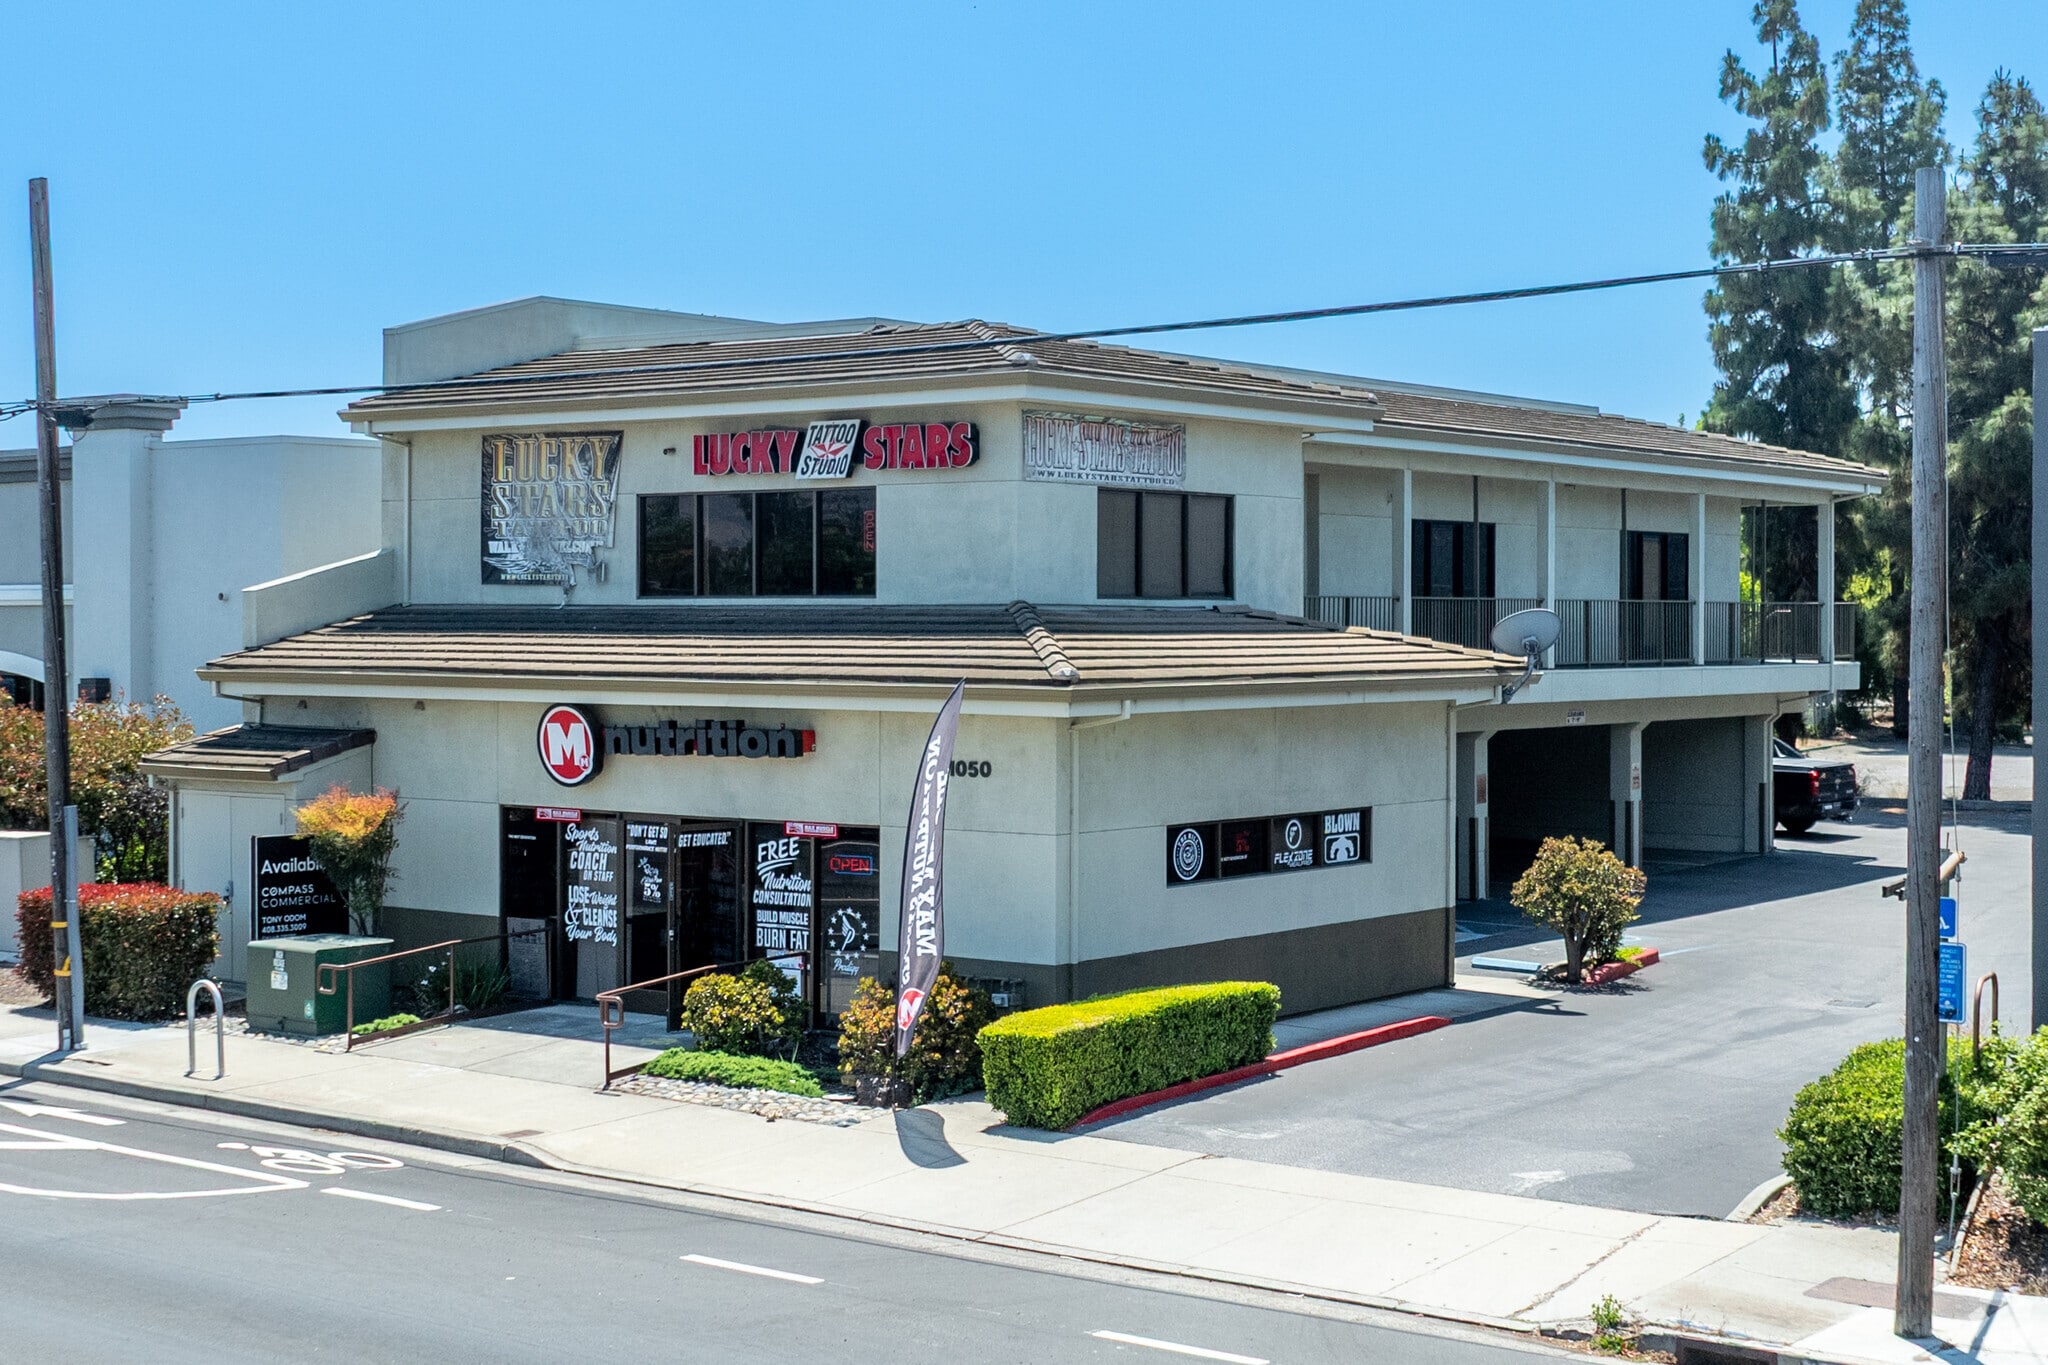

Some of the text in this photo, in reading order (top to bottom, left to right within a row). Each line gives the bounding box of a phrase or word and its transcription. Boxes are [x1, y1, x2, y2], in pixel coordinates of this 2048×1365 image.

[807, 422, 854, 446] TATTOO
[693, 421, 972, 475] LUCKY STARS
[1026, 415, 1183, 477] LUCKY STARS TATTOO
[491, 437, 613, 484] LUCKY
[800, 455, 848, 476] STUDIO
[491, 482, 609, 519] STARS
[604, 719, 802, 758] nutrition
[949, 759, 992, 778] 1050
[565, 822, 599, 842] Sports
[648, 825, 660, 838] GET
[660, 826, 668, 839] SO
[1324, 812, 1360, 834] BLOWN
[576, 840, 617, 854] Nutrition
[678, 833, 692, 847] GET
[758, 837, 800, 862] FREE
[570, 851, 608, 871] COACH
[830, 857, 870, 872] OPEN
[583, 870, 614, 882] ON STAFF
[761, 871, 812, 892] Nutrition
[261, 884, 315, 897] COMPASS
[568, 885, 617, 909] LOSE Weight
[643, 882, 661, 898] 5%
[753, 890, 812, 907] CONSULTATION
[261, 894, 337, 908] COMMERCIAL
[262, 913, 307, 924] TONY ODOM
[582, 908, 617, 928] CLEANSE
[756, 909, 809, 925] BUILD MUSCLE
[566, 924, 617, 947] Your Body
[756, 927, 809, 950] BURN FAT
